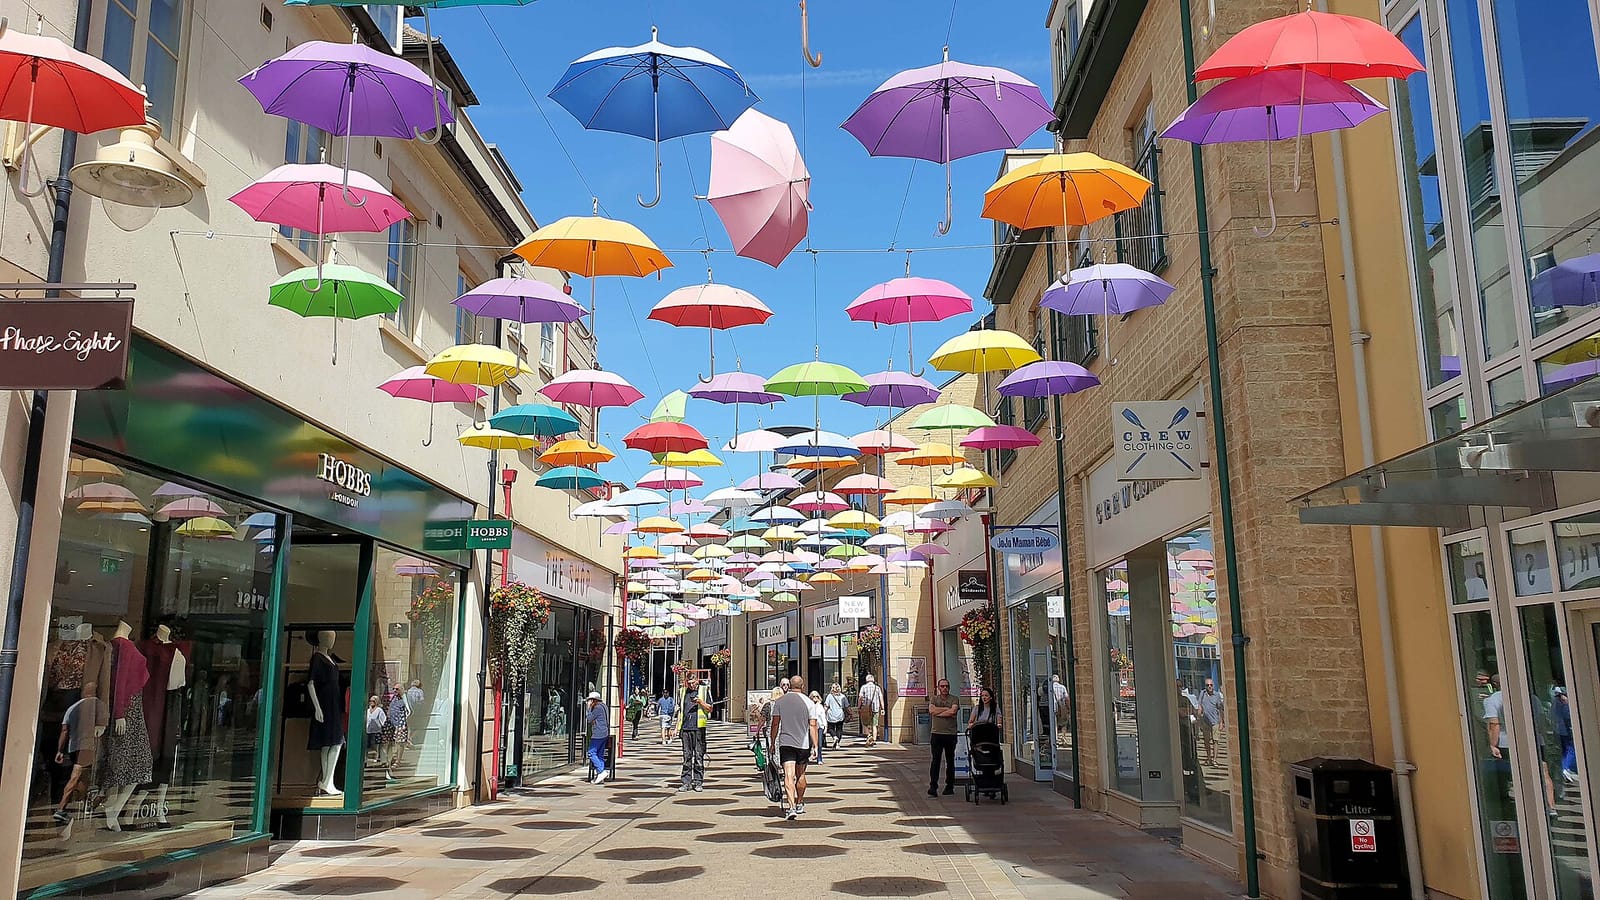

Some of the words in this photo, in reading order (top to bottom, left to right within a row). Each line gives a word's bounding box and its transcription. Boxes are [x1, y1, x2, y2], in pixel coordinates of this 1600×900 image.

[0, 326, 61, 353] Phase
[63, 330, 121, 361] Eight
[1123, 431, 1191, 441] CREW
[1123, 443, 1174, 451] CLOTHING
[318, 453, 371, 496] HOBBS
[332, 491, 359, 508] LONDON
[470, 527, 508, 537] HOBBS
[997, 537, 1011, 548] JoJo
[1012, 537, 1034, 548] Maman
[545, 551, 564, 590] THE
[568, 562, 591, 599] SHOP
[816, 616, 832, 628] NEW
[832, 612, 851, 626] LO
[759, 625, 769, 639] NEW
[769, 624, 782, 637] LOOK
[1345, 805, 1372, 815] Litter
